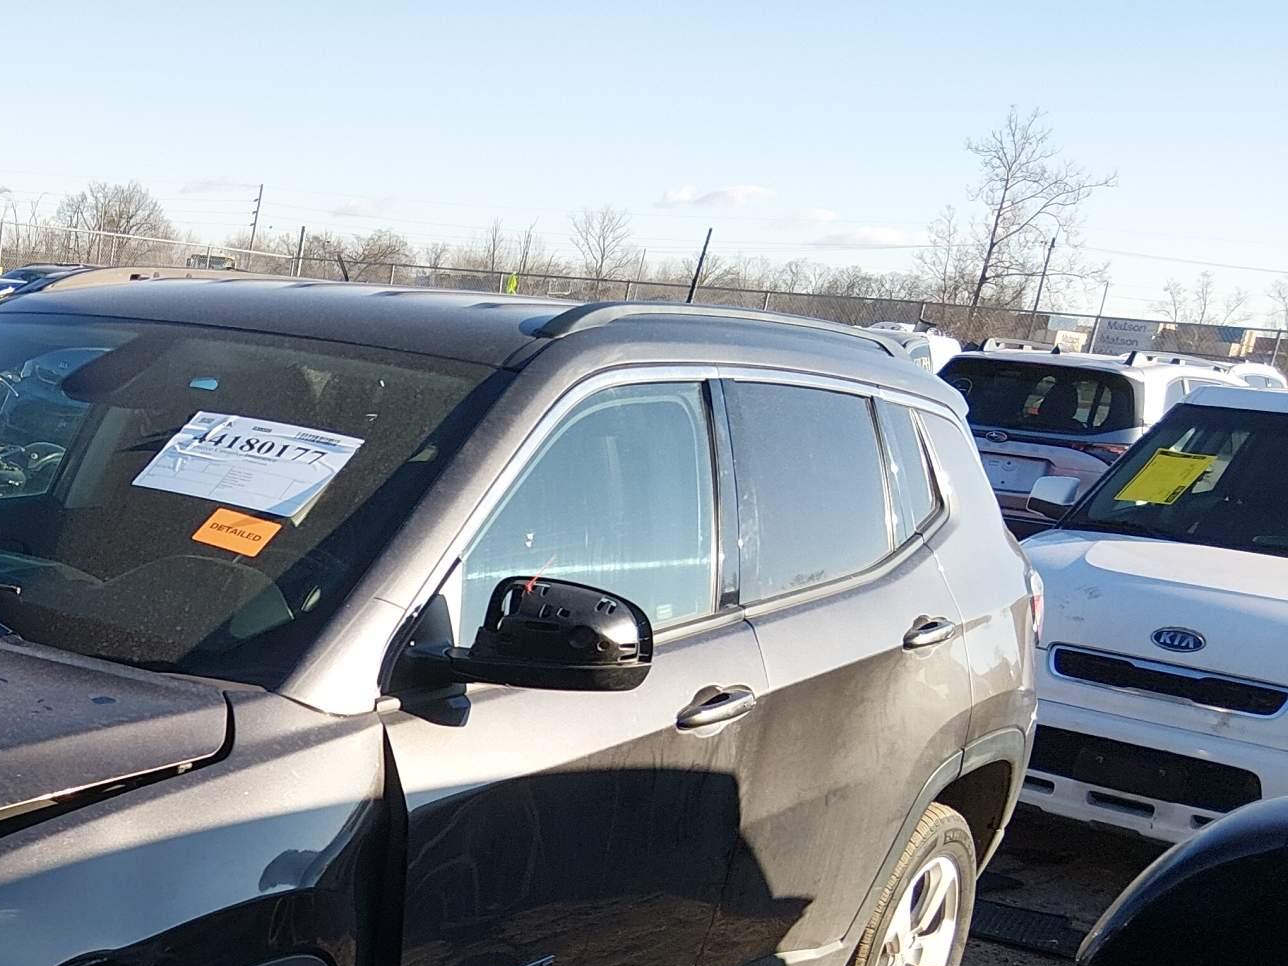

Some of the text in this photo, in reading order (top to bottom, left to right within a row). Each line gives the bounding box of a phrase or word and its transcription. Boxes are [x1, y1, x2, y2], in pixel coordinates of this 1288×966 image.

[192, 431, 328, 465] 44180177
[209, 521, 262, 543] DETAILED
[1159, 631, 1194, 649] KIA
